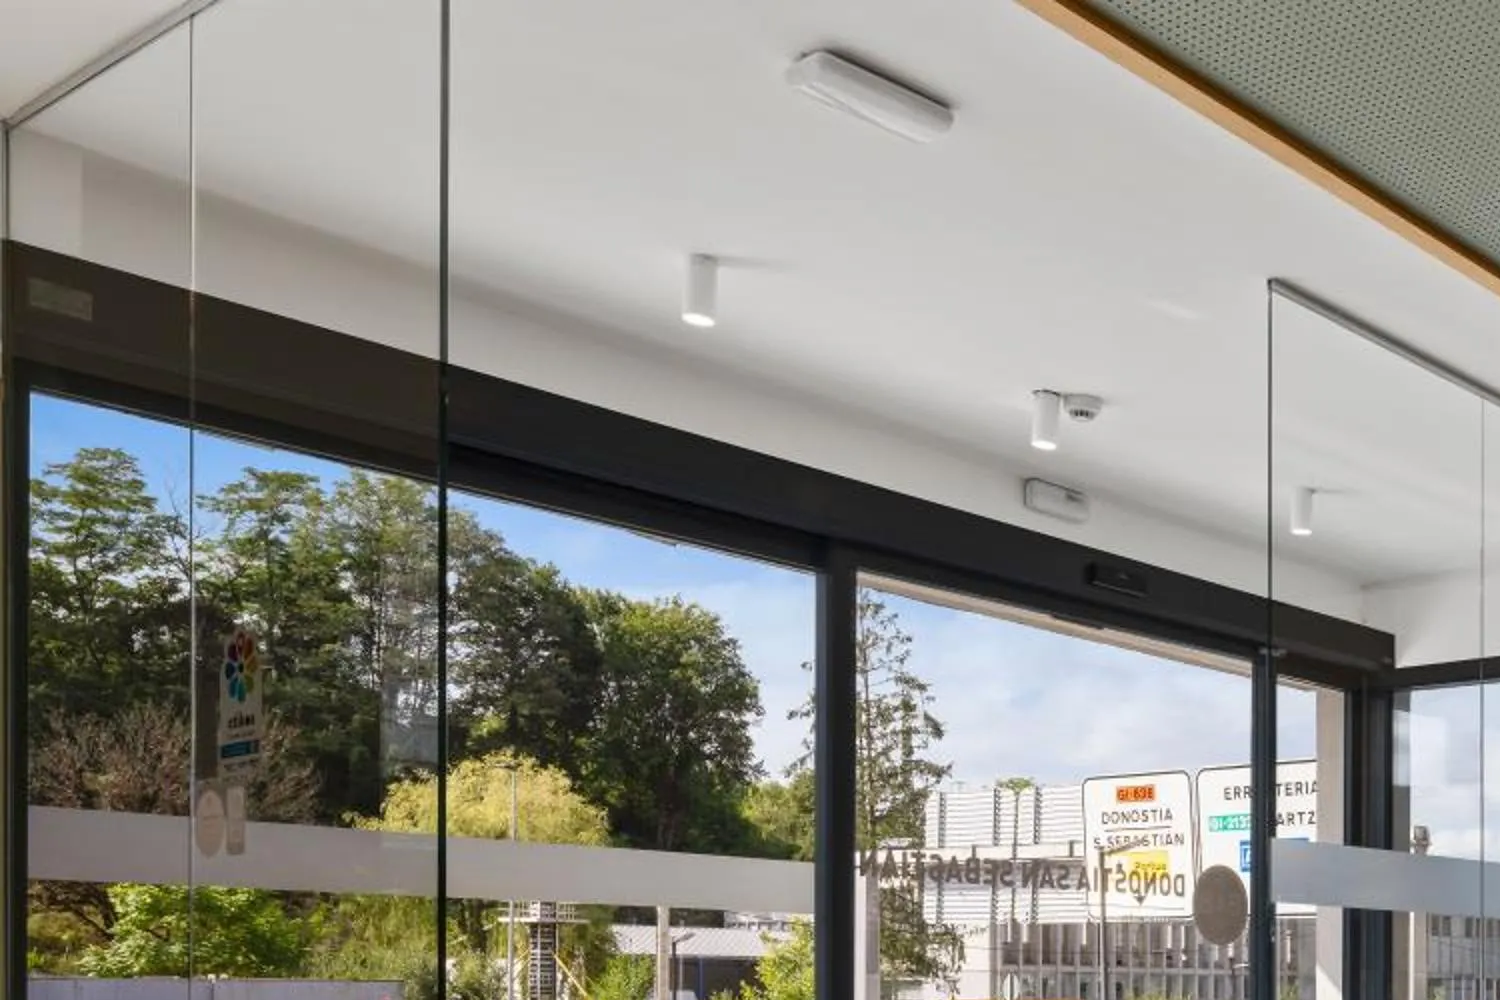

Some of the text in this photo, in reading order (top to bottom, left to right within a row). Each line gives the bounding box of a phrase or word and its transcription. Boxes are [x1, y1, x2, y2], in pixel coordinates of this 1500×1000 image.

[1223, 781, 1319, 801] ERRTERIA
[1102, 808, 1173, 825] DONOSTIA
[1276, 811, 1316, 825] ARTZ
